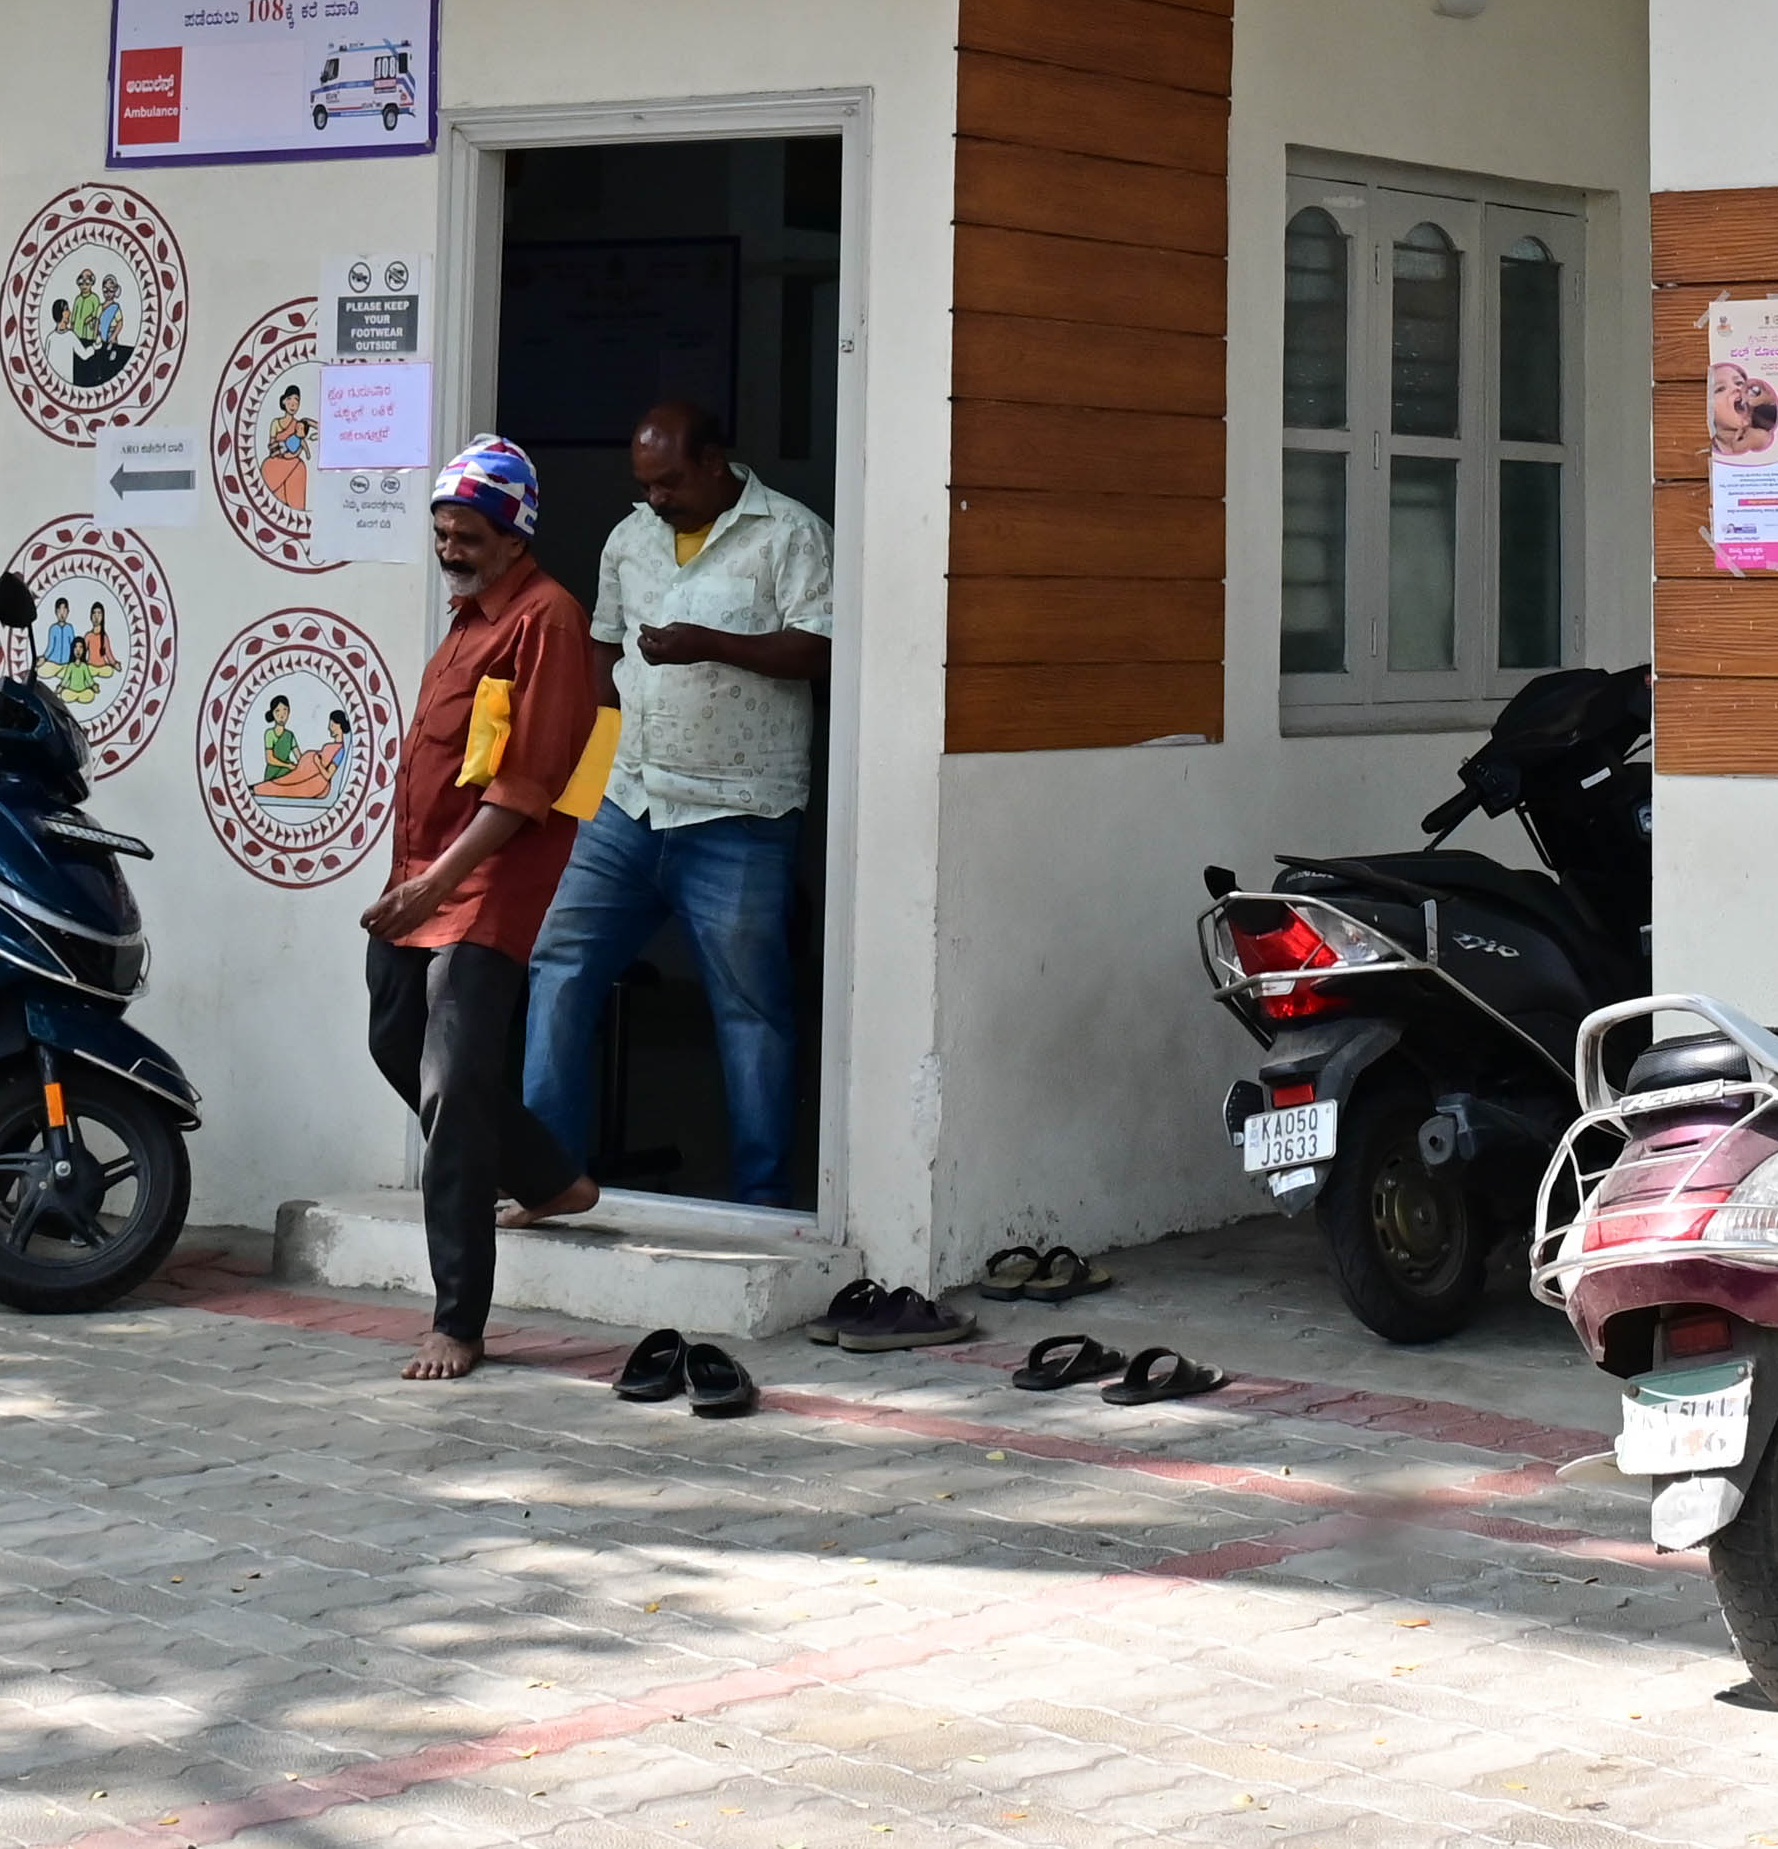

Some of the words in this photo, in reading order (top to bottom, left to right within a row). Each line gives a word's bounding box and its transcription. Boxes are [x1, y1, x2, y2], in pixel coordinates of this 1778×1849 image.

[124, 104, 179, 118] Ambulance
[346, 301, 382, 312] PLEASE
[384, 300, 409, 310] KEEP
[364, 315, 390, 324] YOUR
[351, 328, 403, 338] FOOTWEAR
[355, 340, 397, 350] OUTSIDE
[1261, 1134, 1318, 1166] J3633
